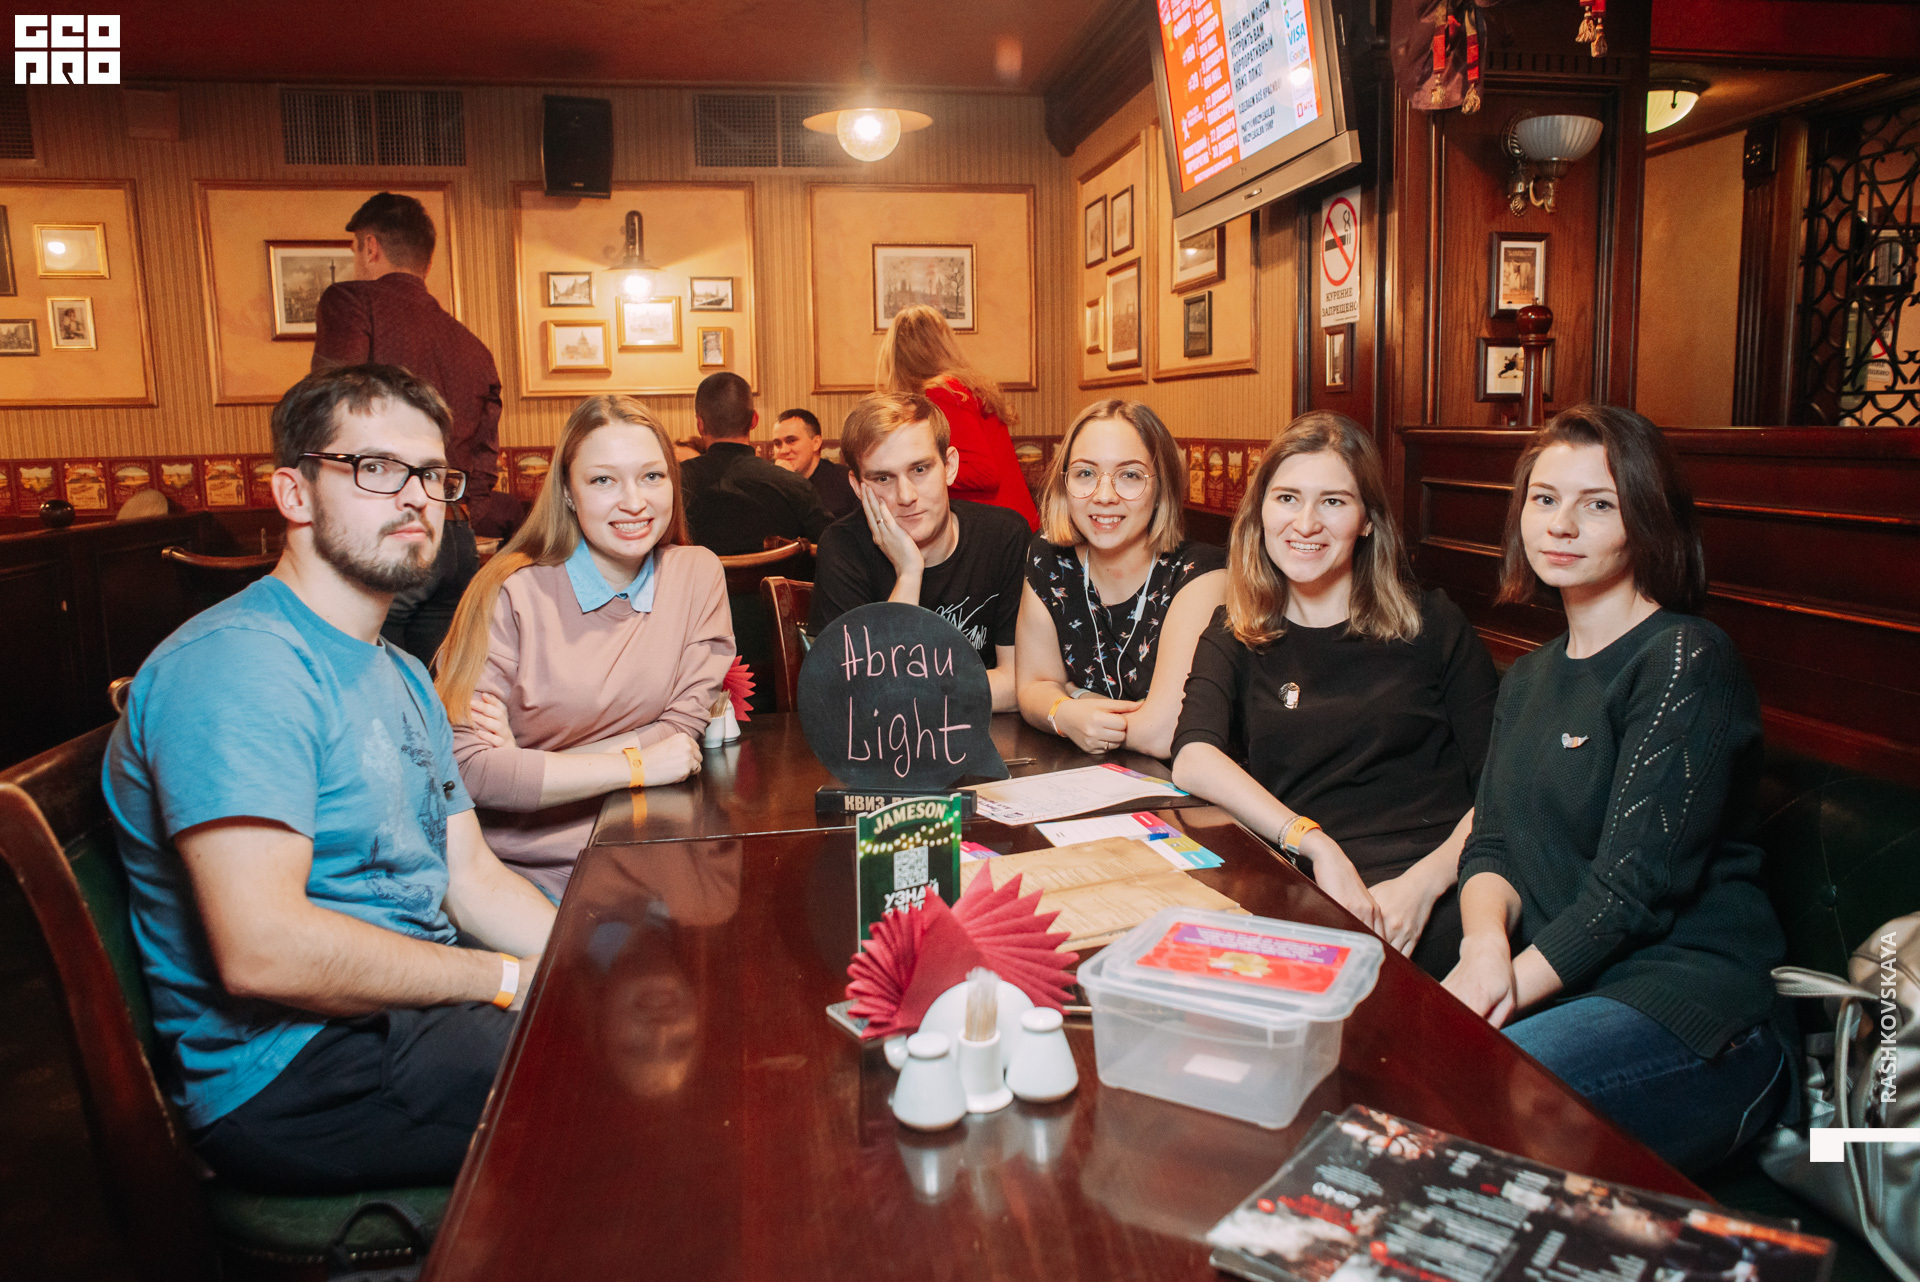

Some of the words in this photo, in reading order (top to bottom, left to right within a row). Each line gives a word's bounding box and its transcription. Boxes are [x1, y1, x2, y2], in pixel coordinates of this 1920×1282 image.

[1242, 13, 1251, 32] МЫ
[1253, 22, 1264, 41] ВАМ
[1287, 22, 1306, 45] VISA
[1233, 33, 1274, 76] КОРПОРАТИВНЫЙ
[1289, 44, 1307, 62] Google
[1325, 287, 1353, 302] КУРЕНИЕ
[1321, 301, 1358, 317] ЗАПРЕЩЕНО
[841, 624, 953, 681] Abrau
[848, 695, 971, 778] Light
[844, 795, 885, 811] КВИЗ
[873, 802, 947, 835] JAMESON
